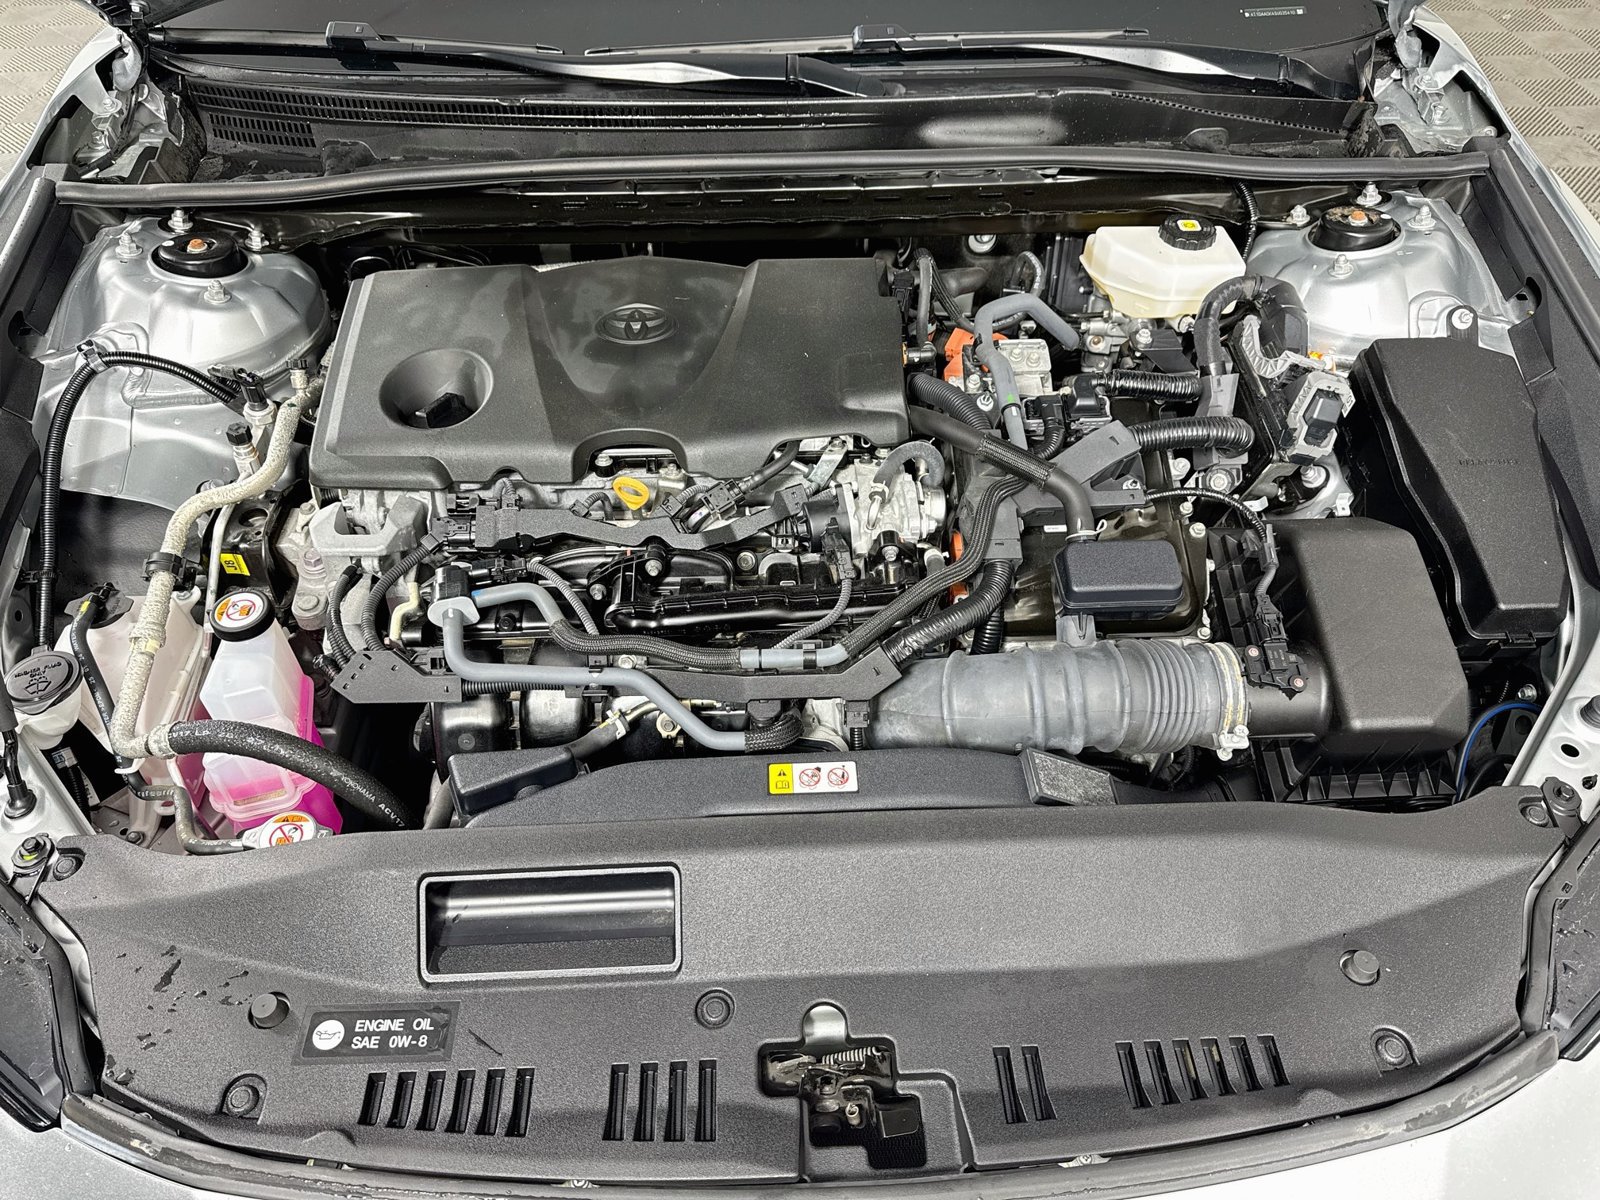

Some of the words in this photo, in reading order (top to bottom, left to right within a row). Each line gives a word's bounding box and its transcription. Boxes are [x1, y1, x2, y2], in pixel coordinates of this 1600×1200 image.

[341, 775, 377, 803] YOKOHAMA
[378, 803, 405, 827] ACV17
[354, 1018, 406, 1032] ENGINE
[412, 1017, 435, 1031] OIL
[351, 1036, 381, 1049] SAE
[388, 1035, 428, 1048] 0W-8
